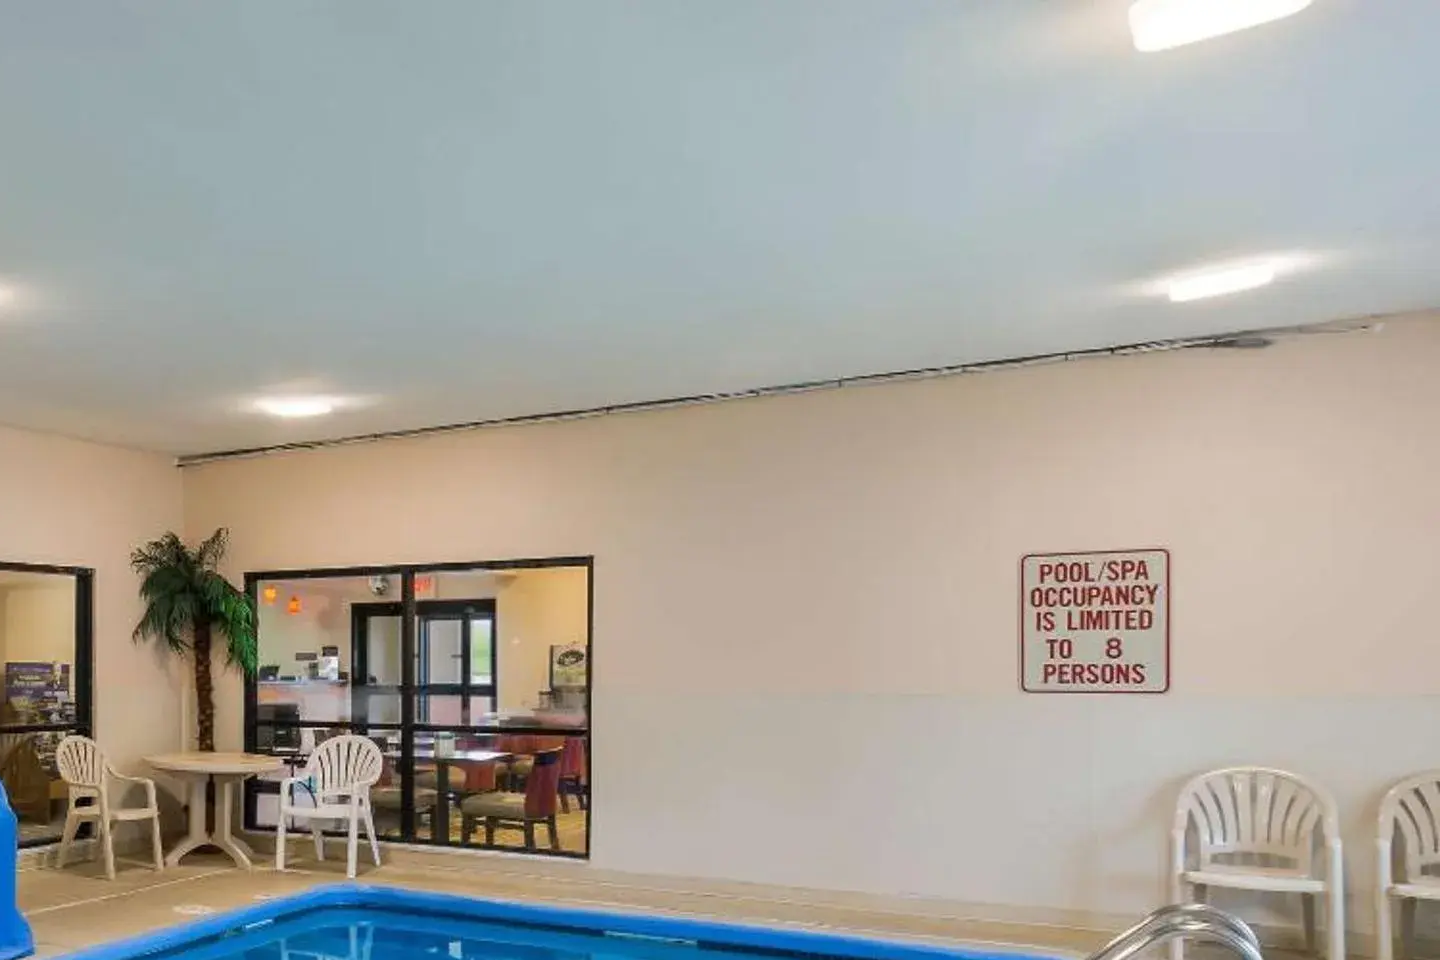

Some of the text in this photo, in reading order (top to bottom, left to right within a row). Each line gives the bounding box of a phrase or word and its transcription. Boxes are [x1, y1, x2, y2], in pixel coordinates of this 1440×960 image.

[1039, 560, 1149, 584] POOL/SPA
[1030, 584, 1159, 608] OCCUPANCY
[1036, 610, 1153, 632] IS LIMITED
[1046, 637, 1122, 659] TO 8
[1043, 664, 1146, 684] PERSONS
